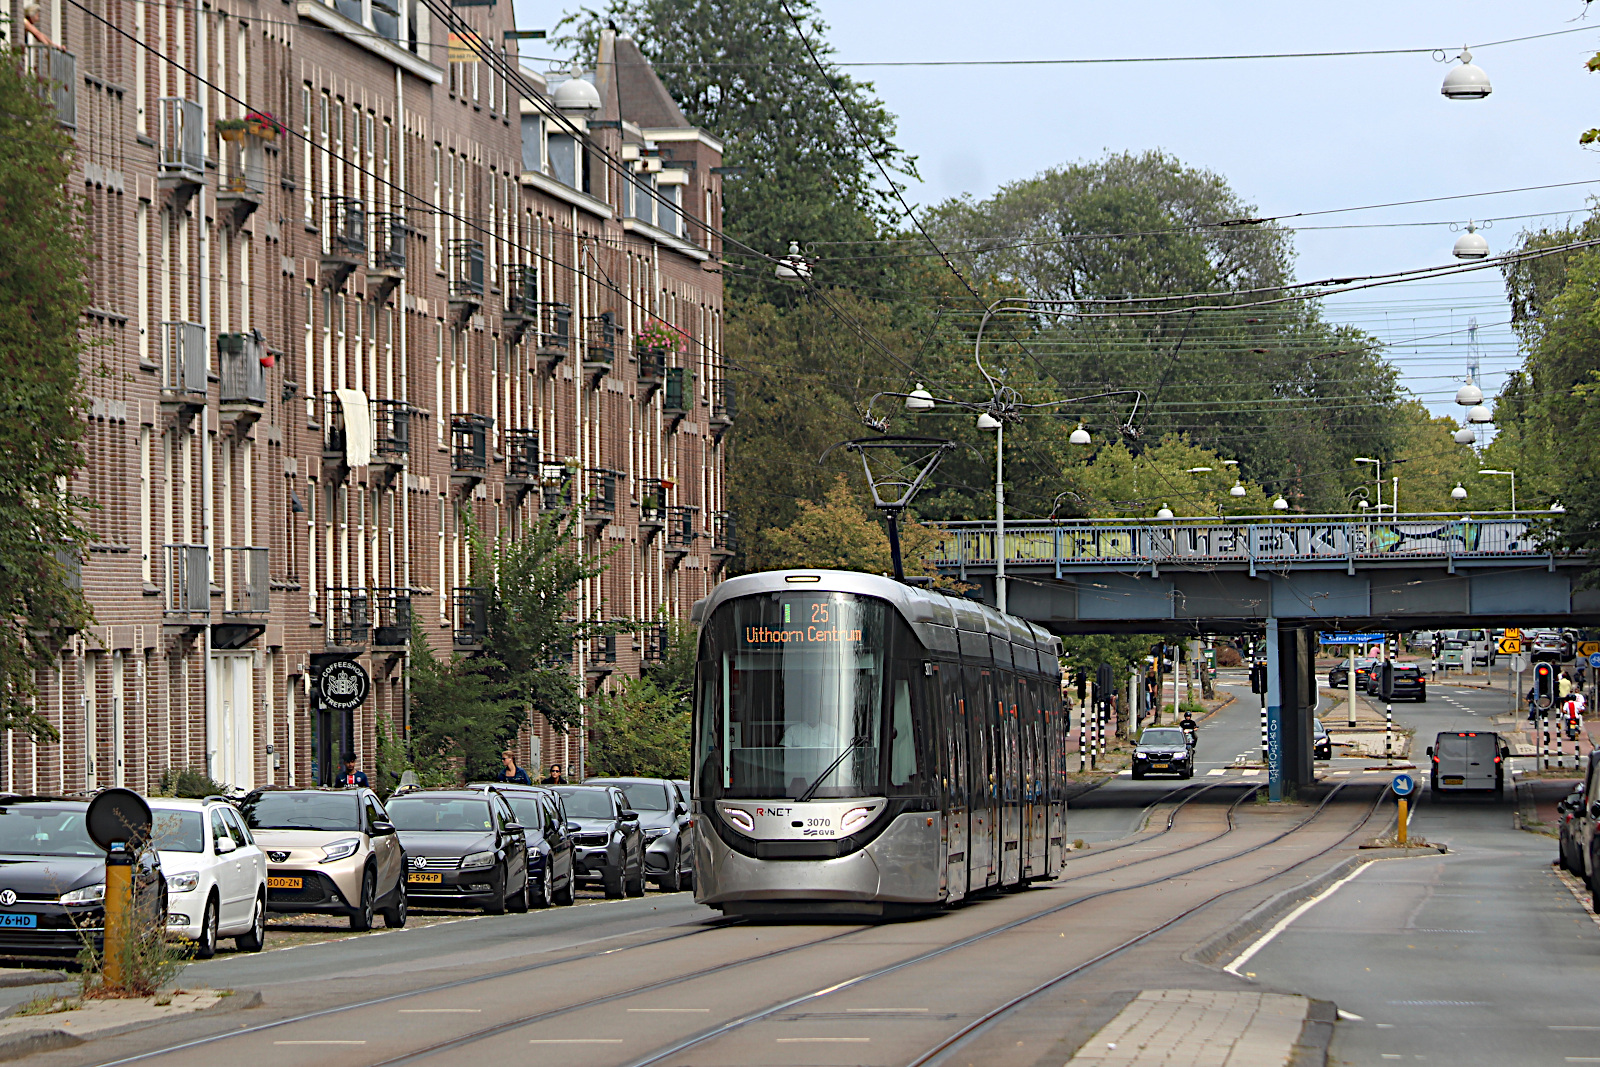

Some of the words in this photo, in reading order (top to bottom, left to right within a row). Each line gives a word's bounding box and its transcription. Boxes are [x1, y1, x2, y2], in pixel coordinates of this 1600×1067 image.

[811, 603, 829, 623] 25
[746, 626, 804, 643] Uithoorn
[807, 625, 862, 642] Centrum
[1508, 641, 1516, 650] A
[322, 661, 364, 678] COFFEESHOP
[325, 696, 361, 709] TREFPUNT
[807, 818, 831, 827] 3070
[267, 878, 300, 887] 800-ZN
[408, 874, 439, 882] F-594-P
[0, 915, 31, 926] 76-HD
